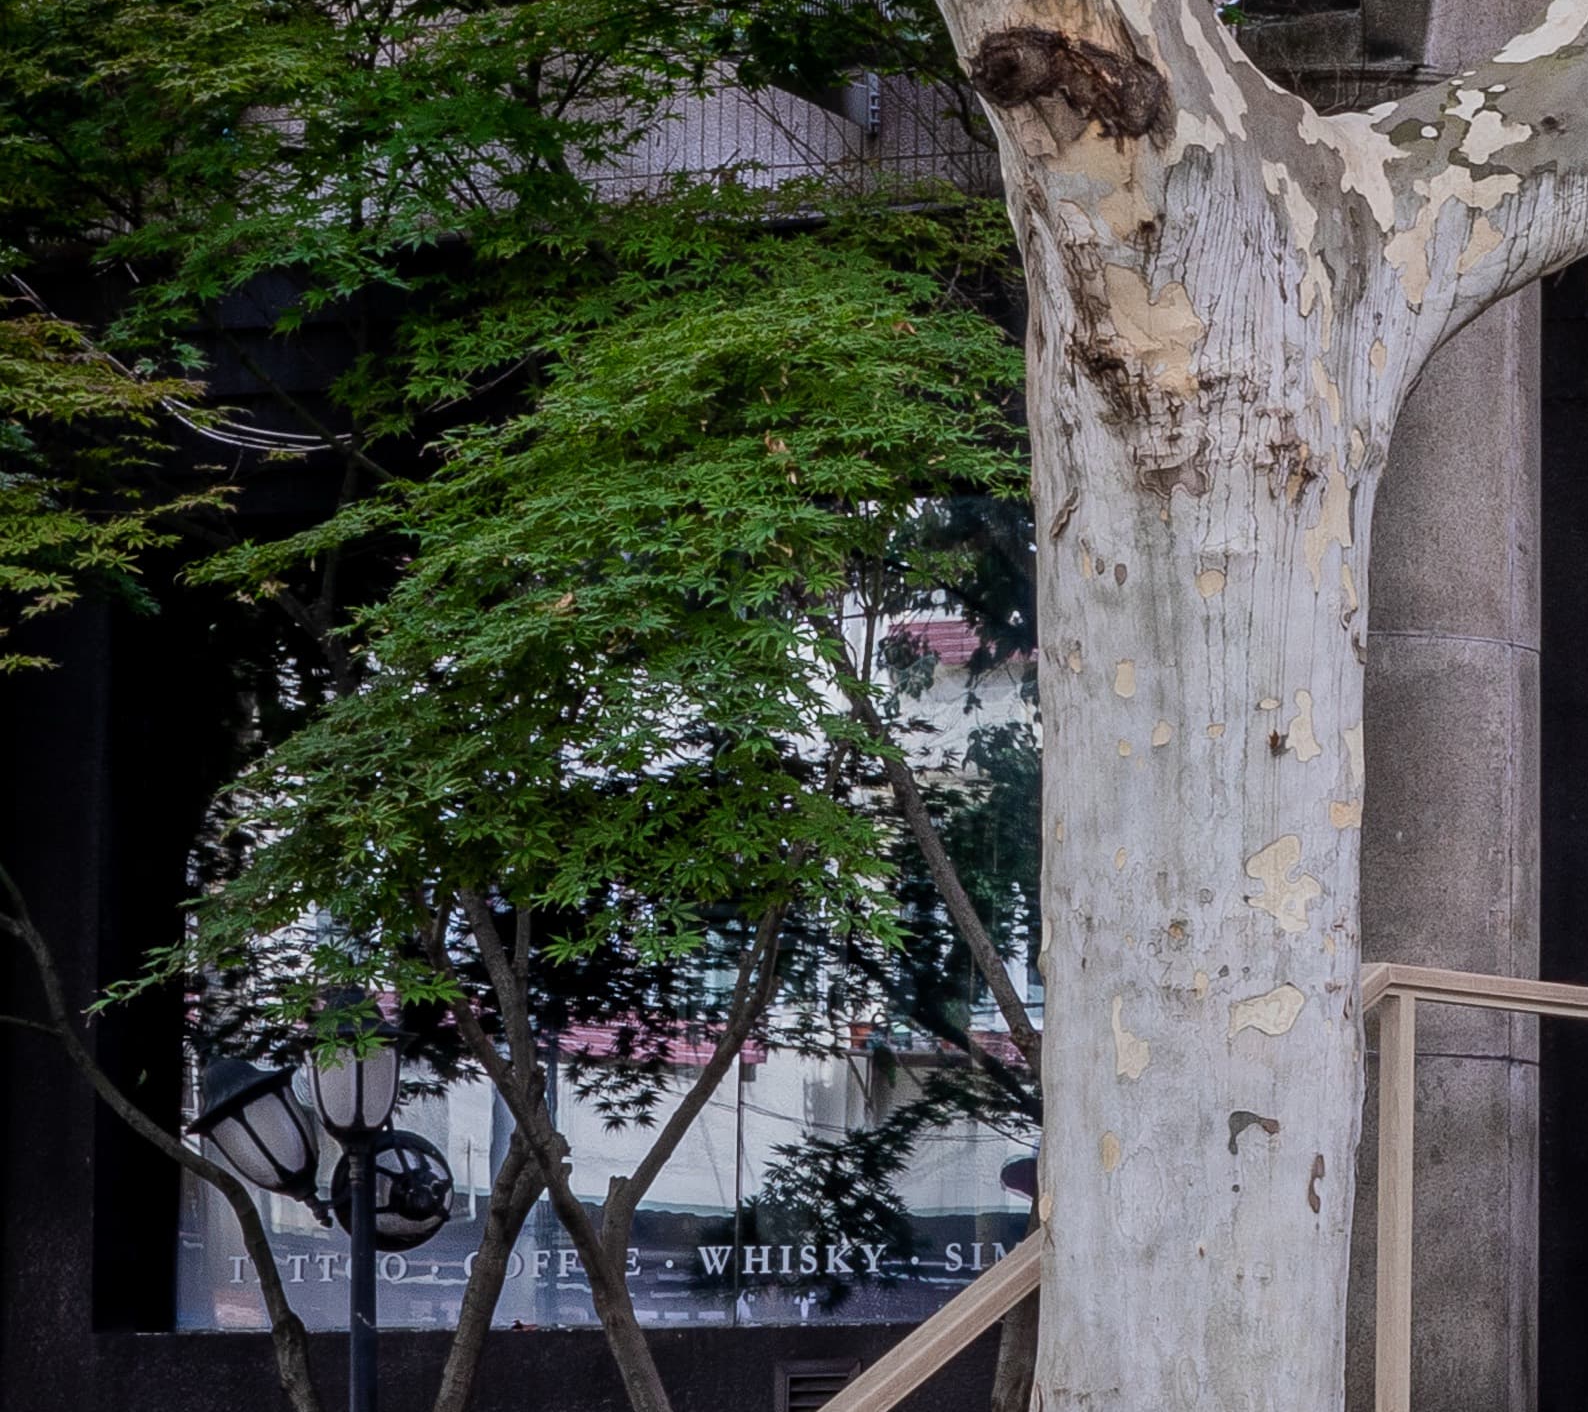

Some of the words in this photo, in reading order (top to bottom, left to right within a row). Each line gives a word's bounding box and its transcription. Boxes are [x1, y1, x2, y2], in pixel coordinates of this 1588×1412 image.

[228, 1252, 407, 1284] TTTO
[463, 1243, 641, 1279] COFFE
[697, 1244, 887, 1276] WHISKY
